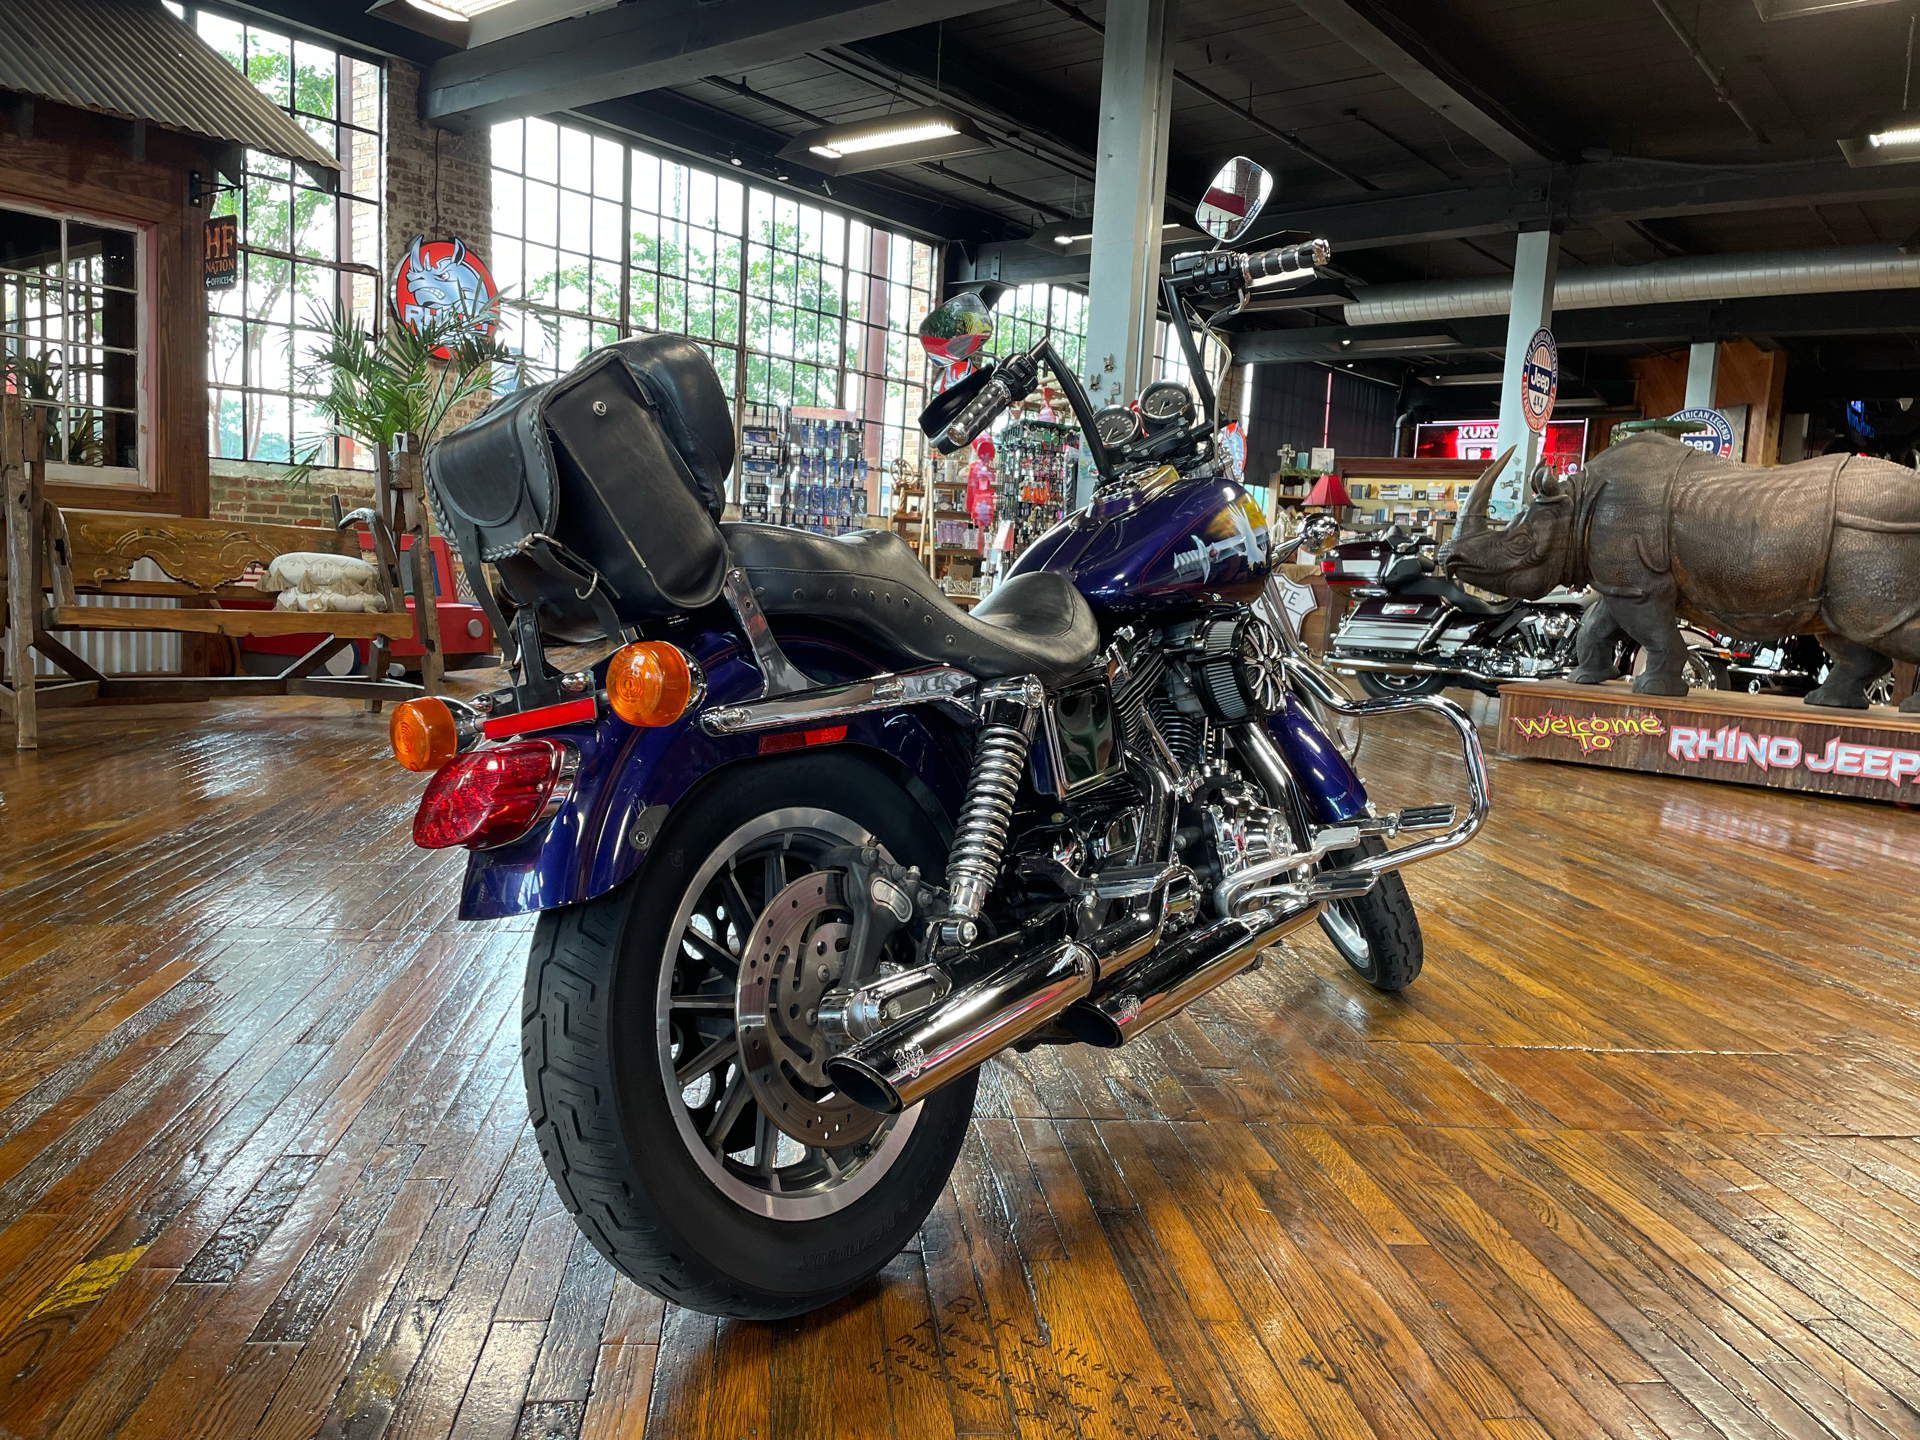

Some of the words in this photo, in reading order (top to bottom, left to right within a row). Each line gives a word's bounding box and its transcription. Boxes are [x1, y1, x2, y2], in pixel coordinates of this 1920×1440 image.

[205, 222, 235, 259] HF
[205, 259, 235, 274] NATION
[210, 275, 230, 286] OFFICES
[1530, 366, 1551, 394] Jeep
[1673, 410, 1711, 422] MERICAN
[1709, 414, 1732, 441] LEGEND
[1514, 713, 1664, 737] Welcome
[1668, 725, 1802, 771] RHINO
[1805, 737, 1920, 786] JEEP
[942, 1295, 1017, 1330] But
[1020, 1334, 1141, 1385] without
